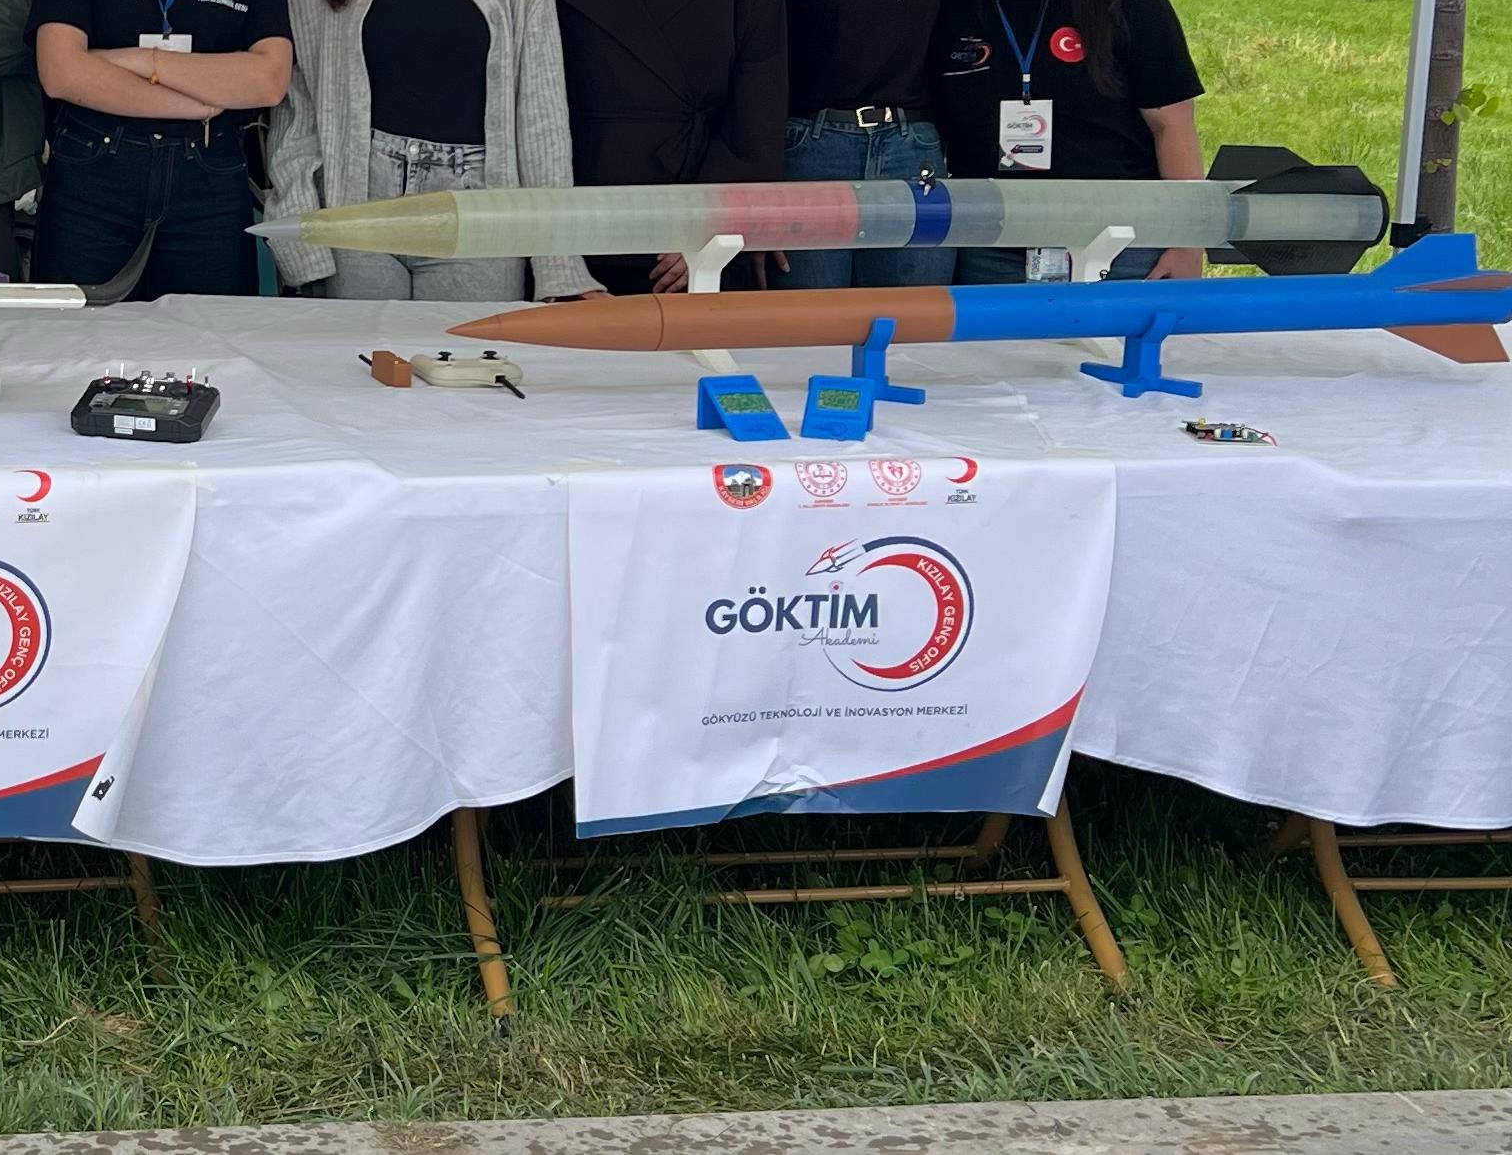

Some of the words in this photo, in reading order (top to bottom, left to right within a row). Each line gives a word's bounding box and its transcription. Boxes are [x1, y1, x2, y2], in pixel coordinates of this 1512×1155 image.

[916, 558, 955, 601] KIZILAY
[705, 582, 879, 635] GÖKTİM
[935, 605, 956, 646] GENÇ
[11, 626, 32, 668] GENÇ
[798, 627, 880, 647] Akademi
[909, 646, 939, 673] OFİS
[701, 712, 757, 726] GÖKYÜZÜ
[759, 706, 822, 721] TEKNOLOJİ
[826, 707, 841, 718] VE
[844, 706, 914, 717] İNOVASYON
[916, 703, 968, 716] MERKEZİ
